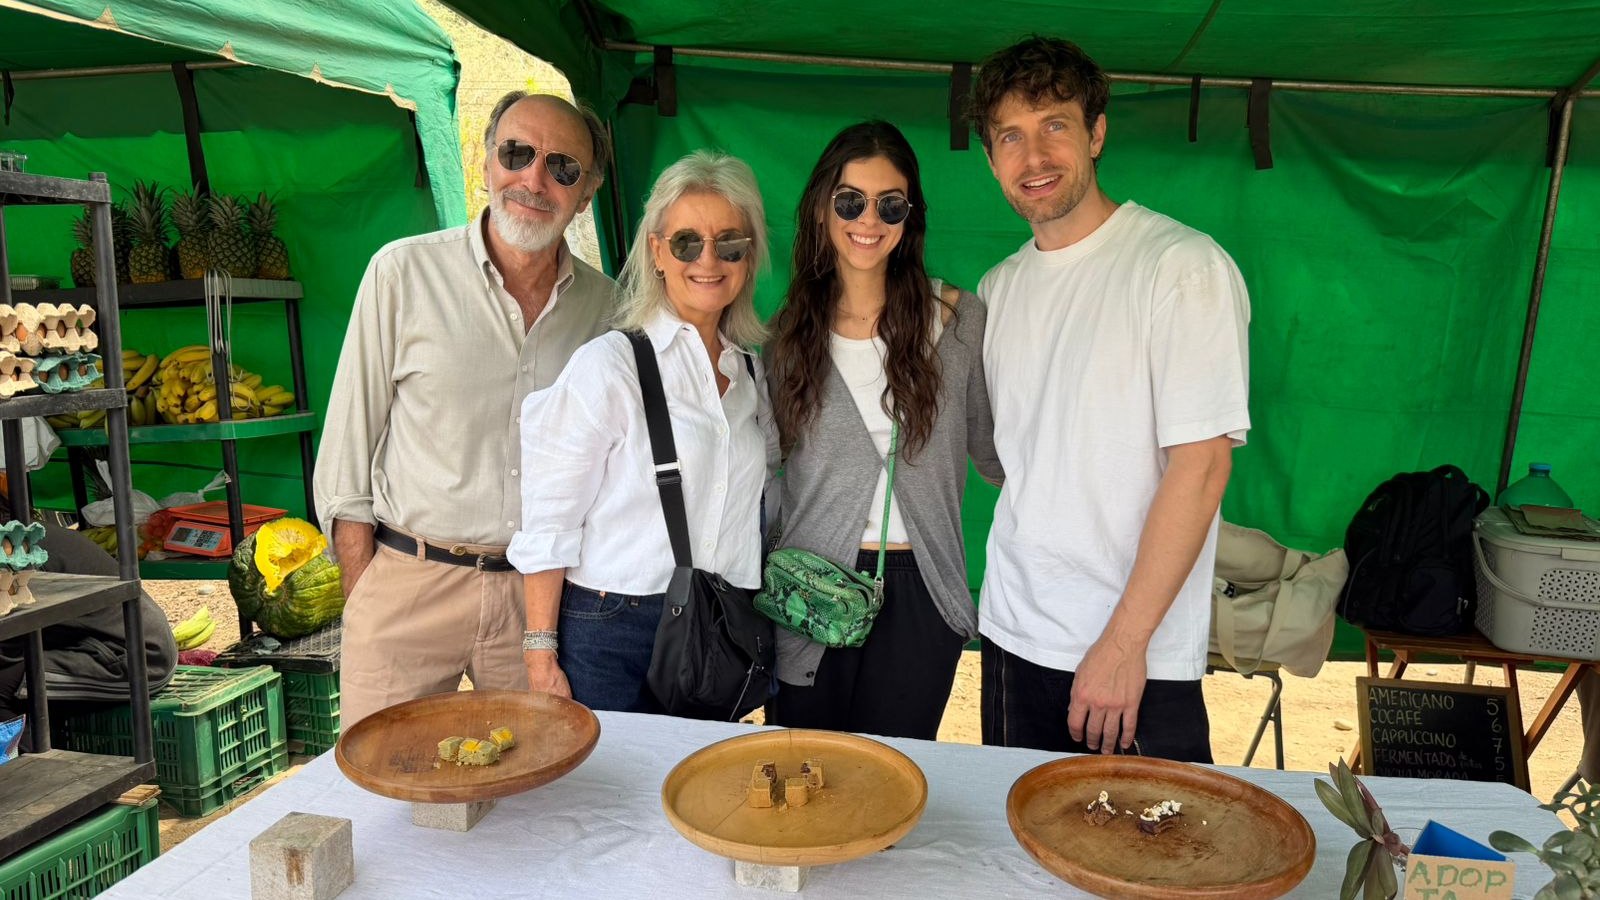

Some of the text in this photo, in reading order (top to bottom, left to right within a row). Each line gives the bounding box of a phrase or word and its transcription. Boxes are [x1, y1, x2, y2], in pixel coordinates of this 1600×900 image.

[1369, 687, 1499, 716] AMERICANO 5
[1491, 718, 1502, 733] 6
[1372, 727, 1503, 754] CAPPUCCINO 7
[1374, 748, 1457, 768] FERMENTADO
[1495, 756, 1505, 771] 5
[1408, 860, 1507, 893] ADOP
